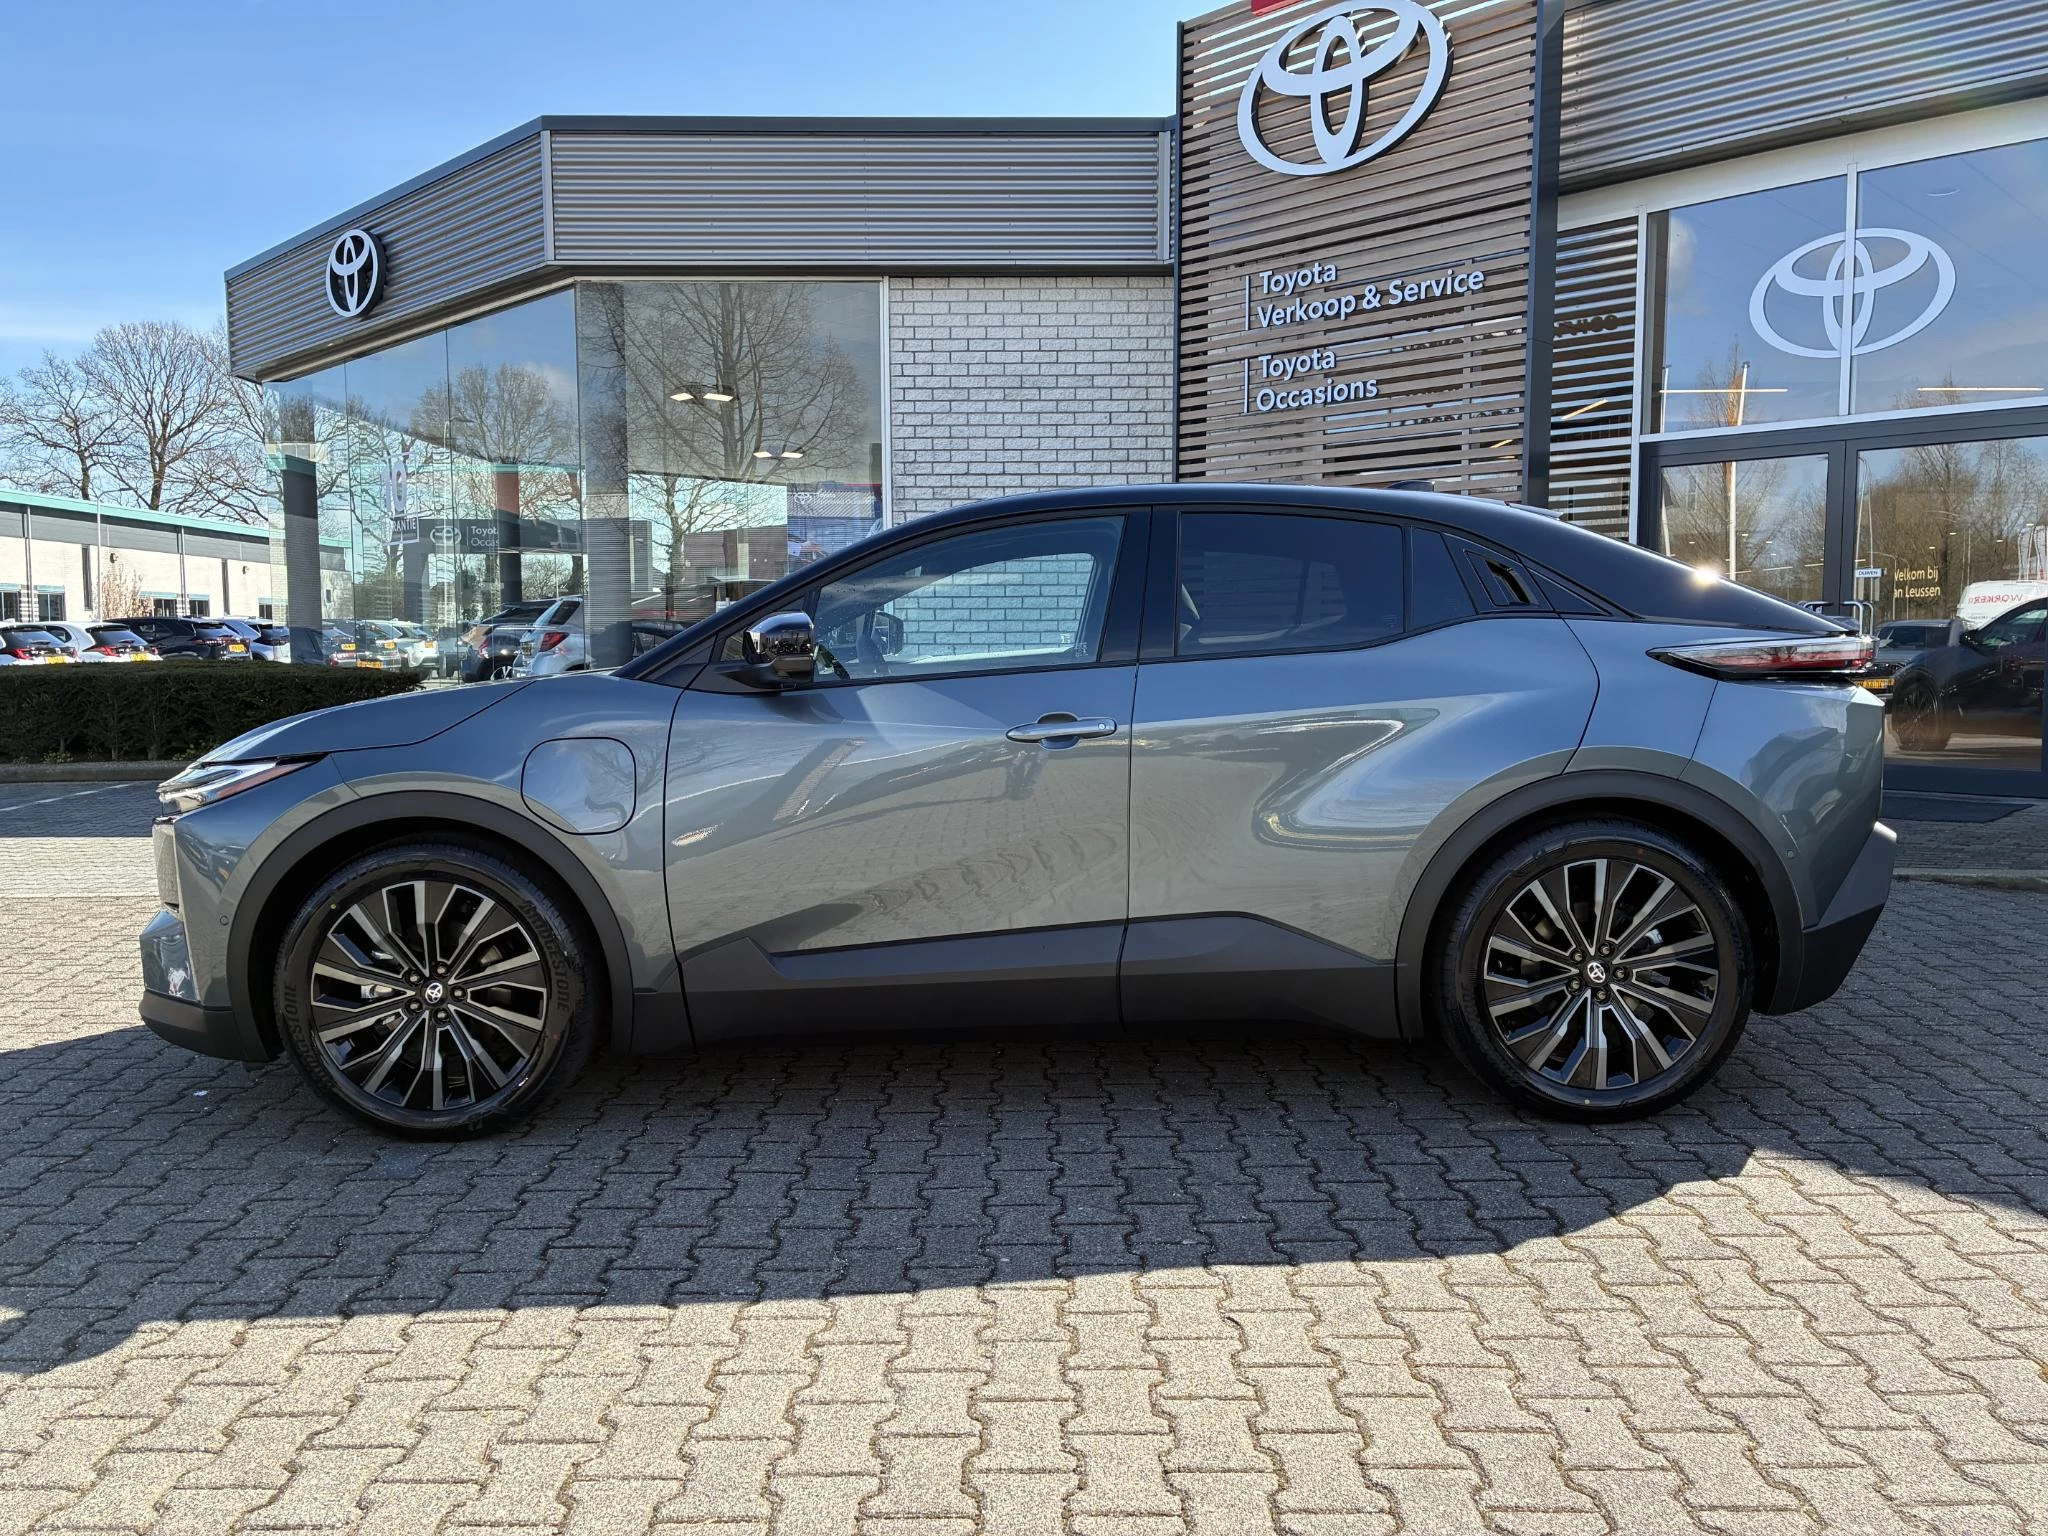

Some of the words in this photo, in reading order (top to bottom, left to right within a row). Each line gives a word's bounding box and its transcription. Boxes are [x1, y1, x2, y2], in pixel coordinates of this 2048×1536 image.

[1259, 262, 1337, 296] Toyota
[1257, 294, 1357, 328] Verkoop
[1362, 284, 1382, 310] &
[1388, 269, 1485, 305] Service
[1258, 349, 1336, 381] Toyota
[1256, 378, 1378, 411] Occasions
[470, 525, 499, 537] Toyot
[470, 537, 500, 548] Occas
[1927, 565, 1939, 581] bij
[1905, 585, 1941, 598] Leussen
